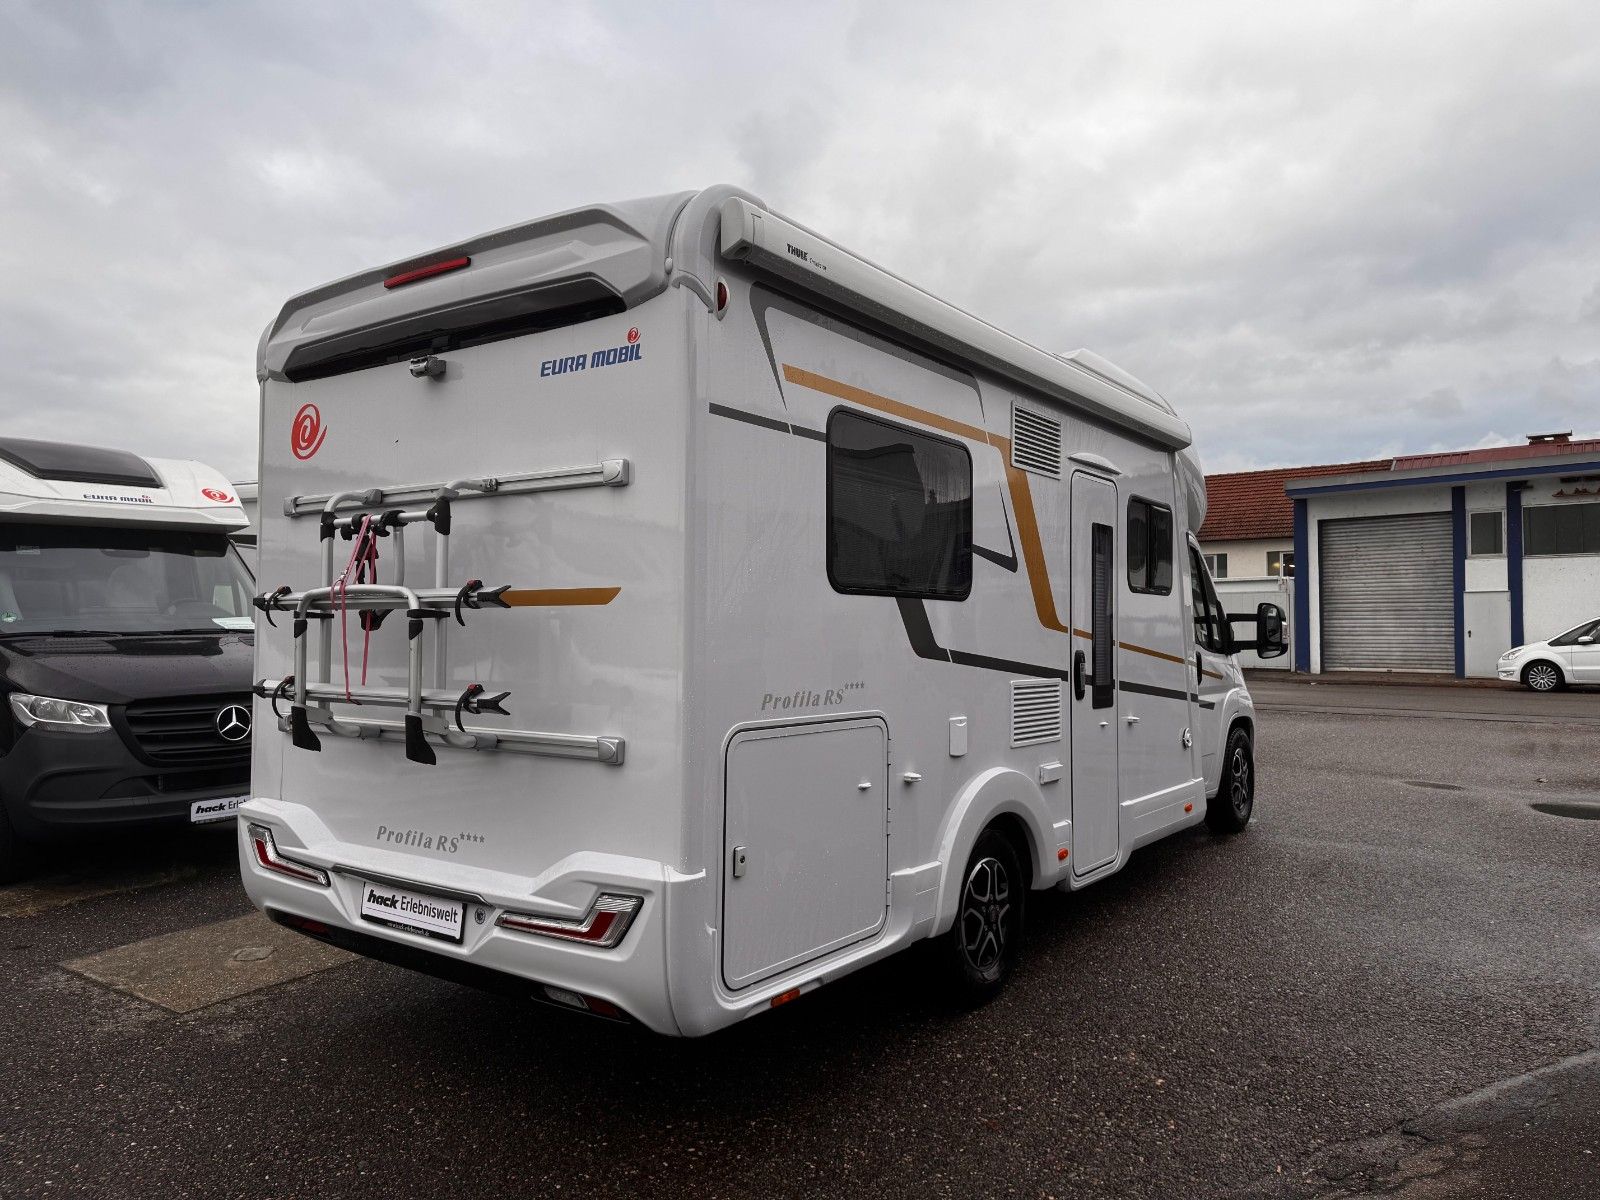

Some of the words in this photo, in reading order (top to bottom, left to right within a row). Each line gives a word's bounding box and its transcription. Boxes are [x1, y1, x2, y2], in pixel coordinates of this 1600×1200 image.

[787, 243, 808, 261] THULE
[540, 354, 587, 377] EURA
[591, 343, 642, 369] MOBIL
[761, 691, 820, 711] Profila
[195, 802, 226, 814] hack
[376, 825, 433, 850] Profila
[367, 889, 399, 909] hack
[400, 896, 458, 923] Erlebniswelt
